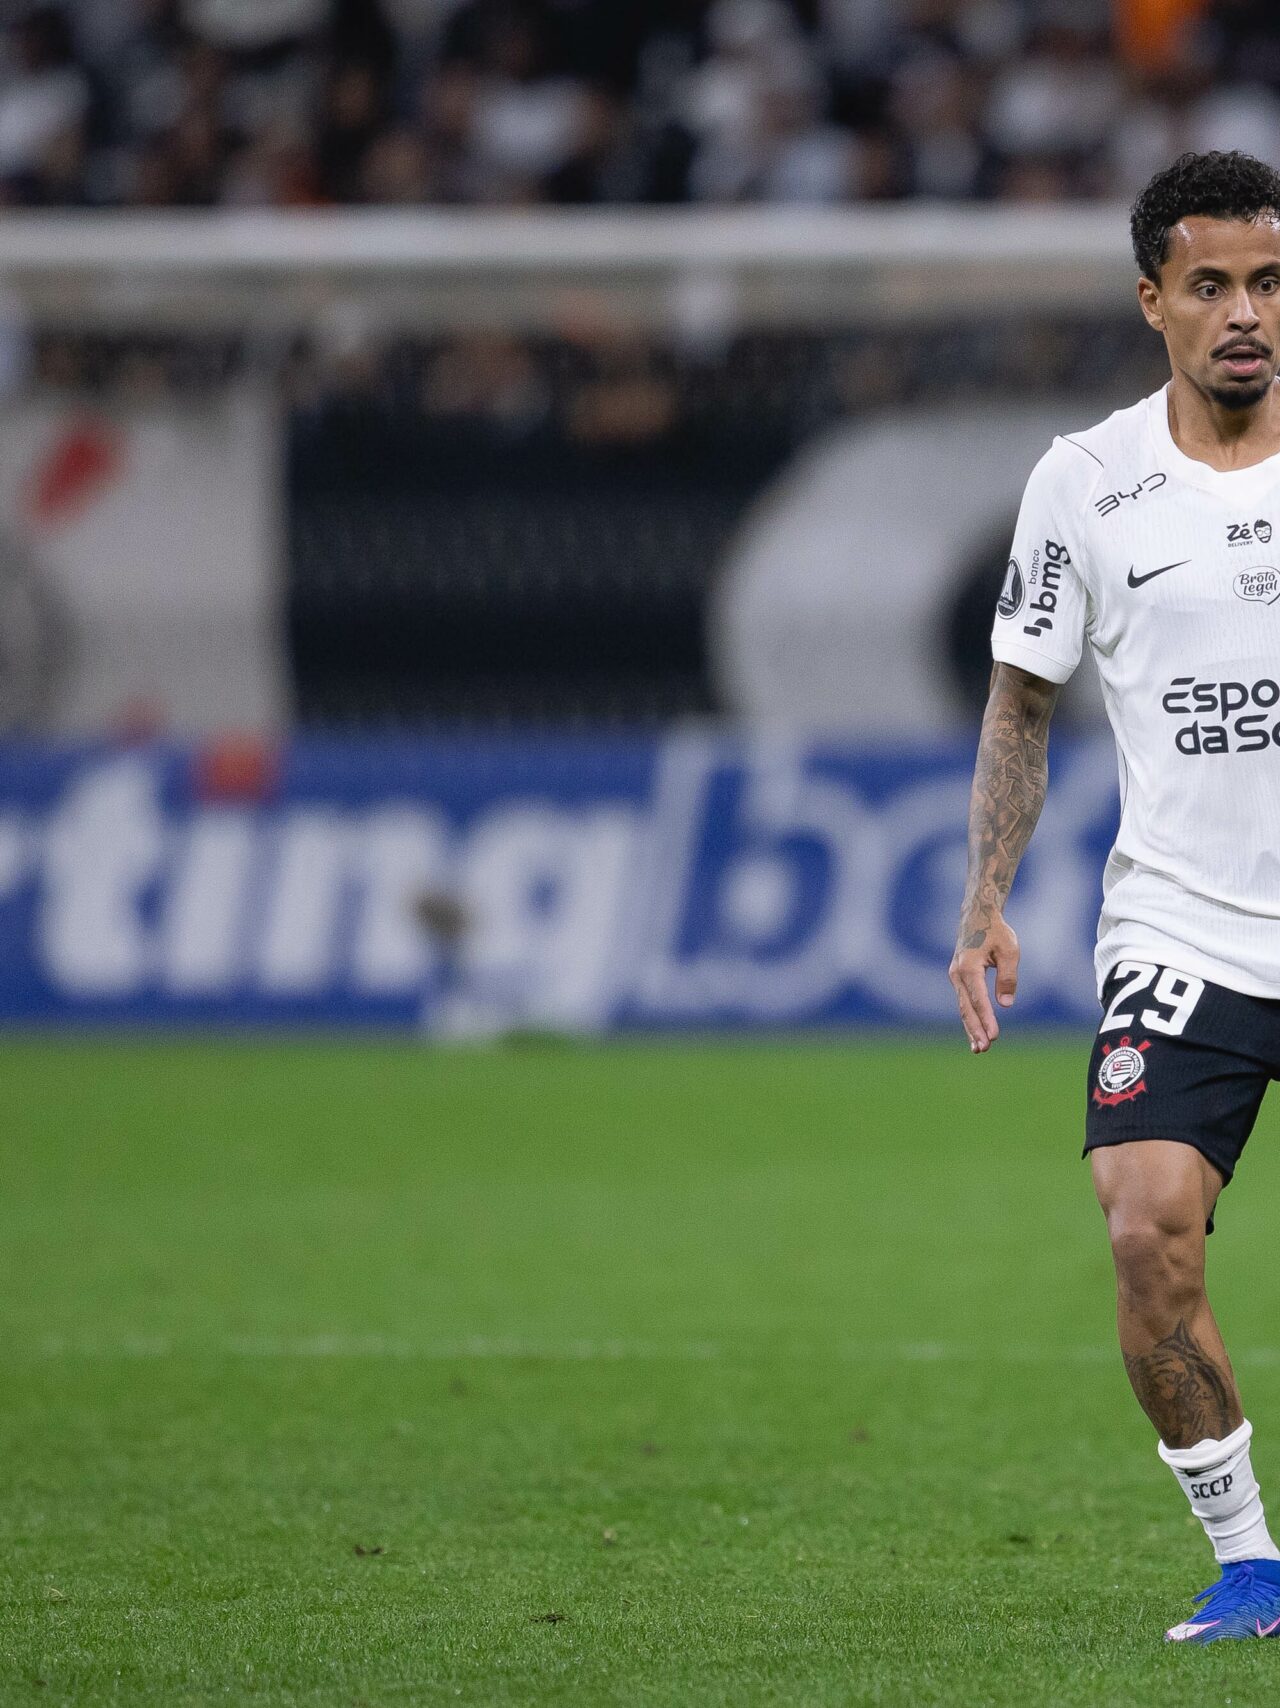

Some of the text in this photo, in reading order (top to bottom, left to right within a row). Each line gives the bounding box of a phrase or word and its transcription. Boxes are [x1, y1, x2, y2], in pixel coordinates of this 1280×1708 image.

[1095, 472, 1167, 518] BYD
[1226, 522, 1253, 542] Zé
[1227, 540, 1254, 548] DELIVERY
[1027, 549, 1040, 585] banco
[1029, 539, 1072, 614] bmg
[1238, 571, 1276, 585] Broto
[1243, 579, 1278, 597] Legal
[1098, 960, 1206, 1036] 29
[1190, 1473, 1233, 1499] SCCP
